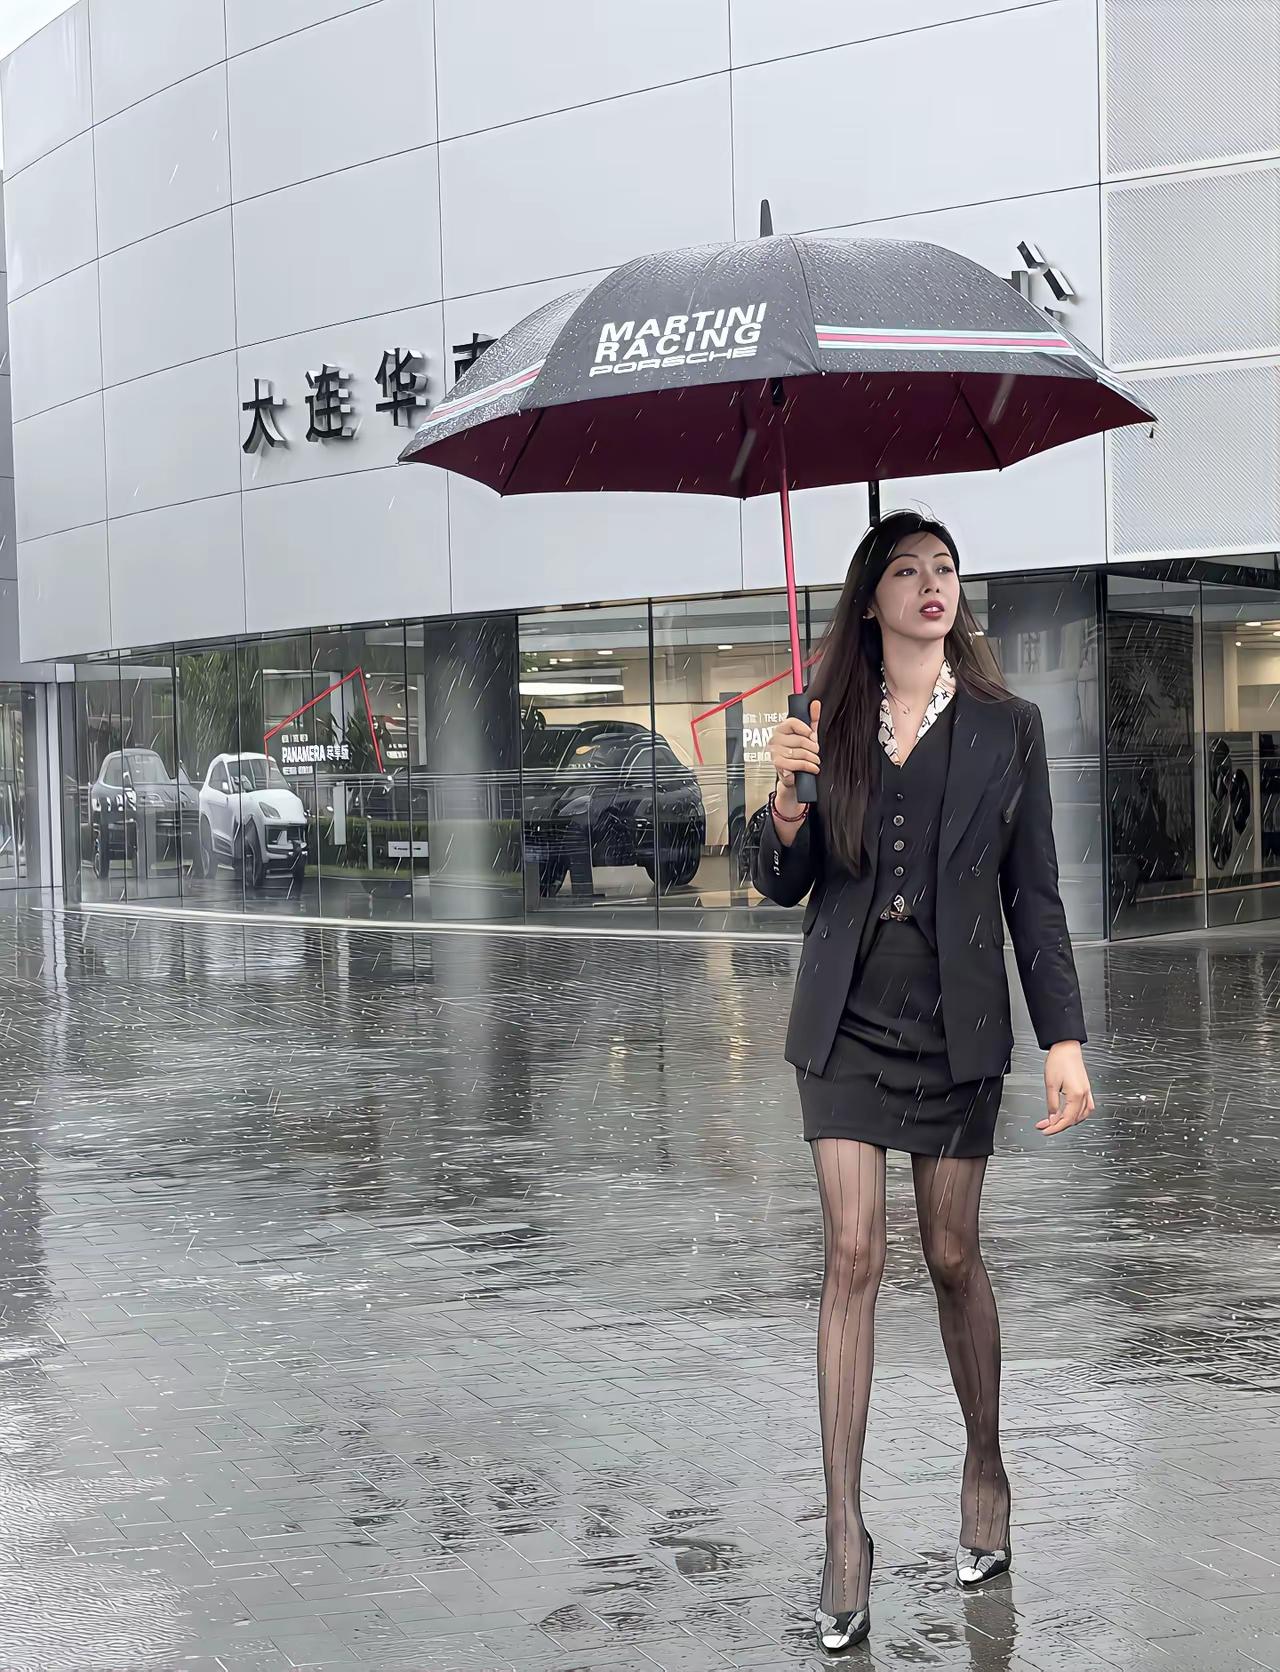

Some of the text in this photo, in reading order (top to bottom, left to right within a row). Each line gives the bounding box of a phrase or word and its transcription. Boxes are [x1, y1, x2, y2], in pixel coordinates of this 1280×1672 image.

[600, 302, 767, 342] MARTINI
[594, 323, 762, 363] RACING
[588, 345, 758, 378] PORSCHE
[282, 745, 326, 763] PANAMERA
